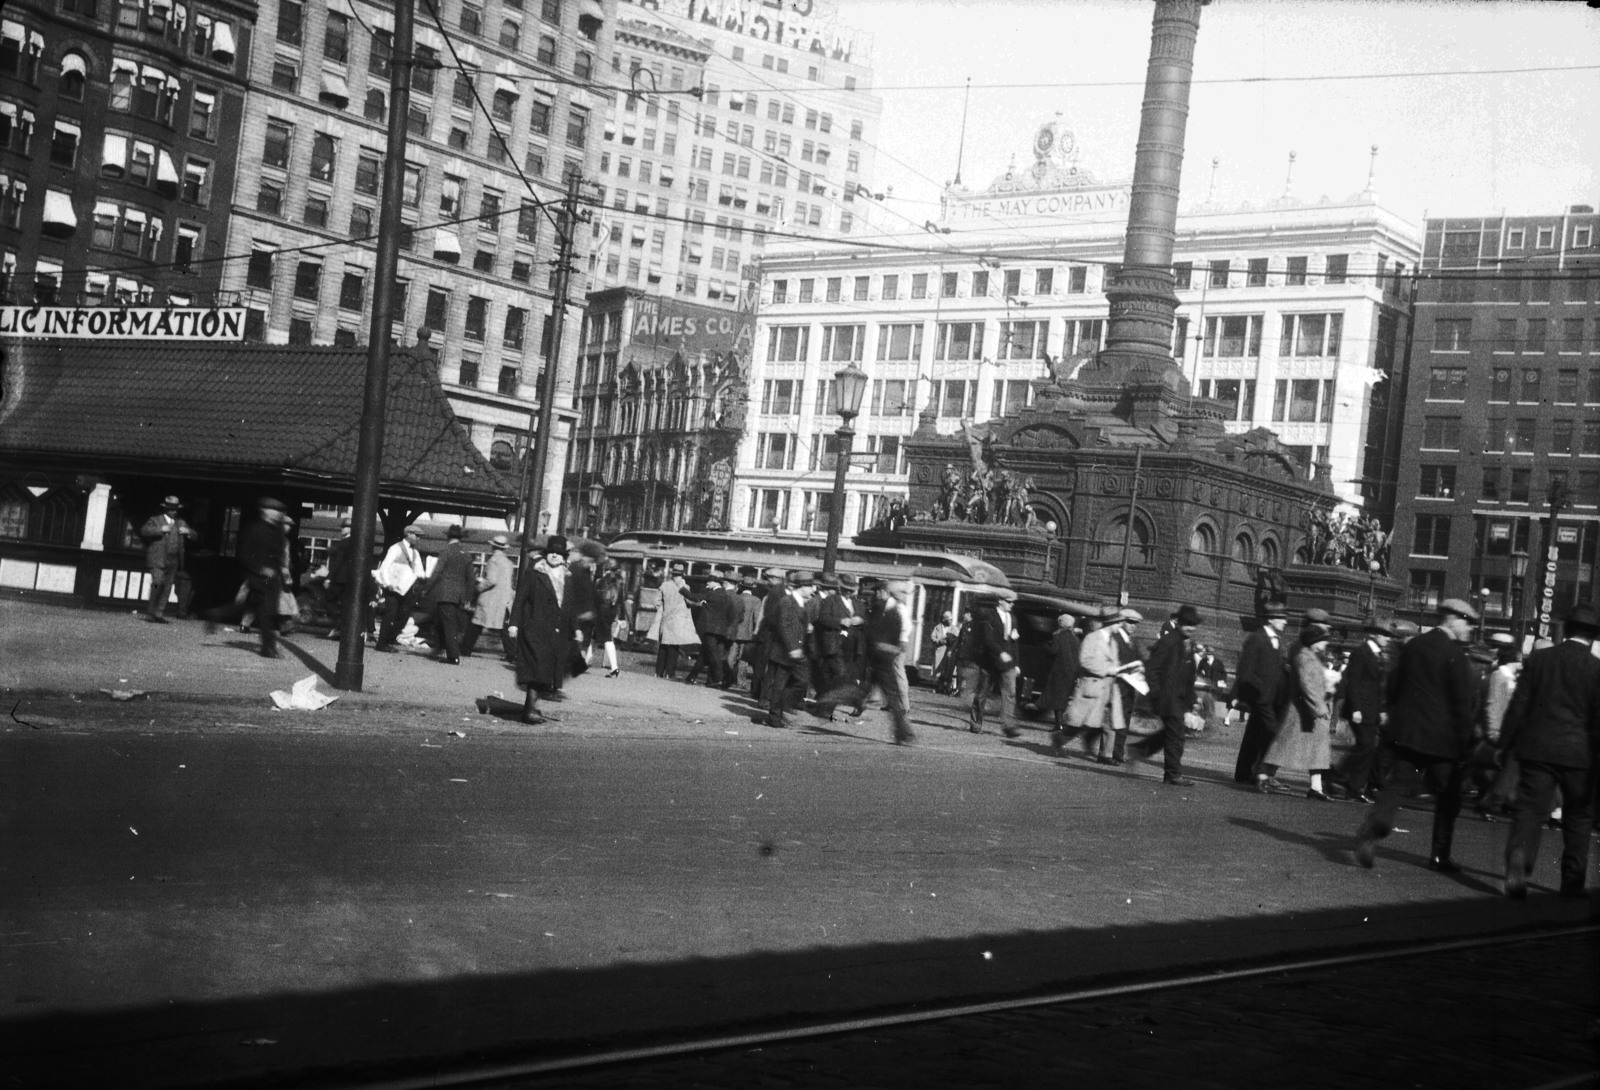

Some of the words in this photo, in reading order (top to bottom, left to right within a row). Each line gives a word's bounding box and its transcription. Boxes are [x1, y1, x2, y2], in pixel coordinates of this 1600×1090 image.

[962, 202, 992, 218] THE
[999, 199, 1031, 216] MAY
[1036, 192, 1119, 214] COMPANY
[636, 300, 659, 315] THE
[43, 309, 242, 337] INFORMATION
[634, 315, 697, 336] AMES
